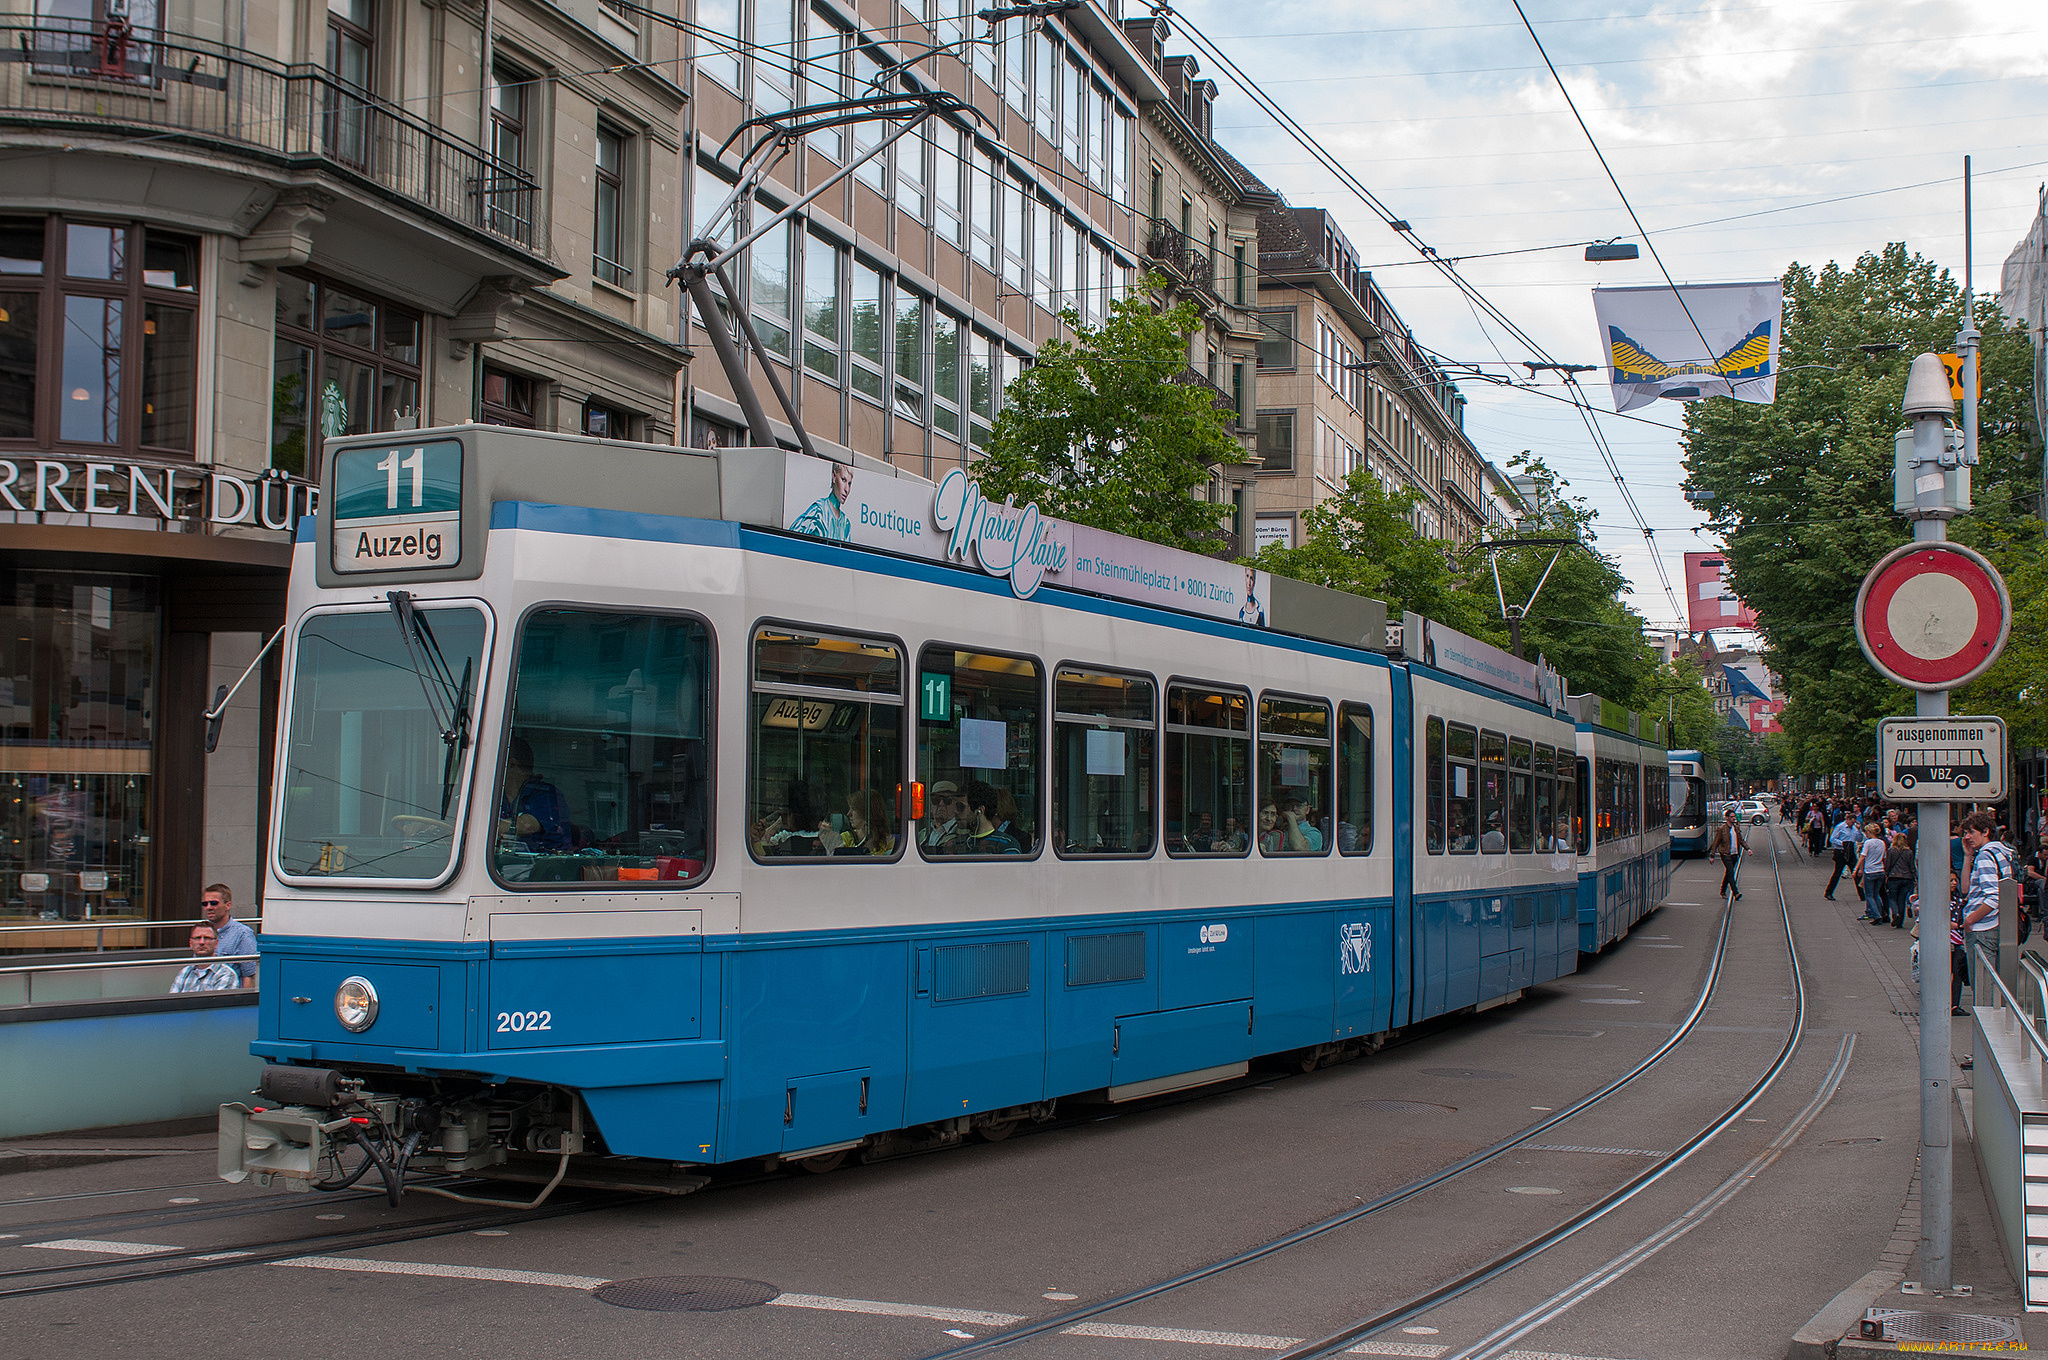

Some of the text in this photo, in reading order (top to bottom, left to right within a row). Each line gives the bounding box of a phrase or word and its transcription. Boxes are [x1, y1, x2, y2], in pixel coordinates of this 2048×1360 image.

[377, 447, 424, 509] 11
[355, 528, 442, 560] Auzelg
[860, 470, 1234, 604] Boutique Marie Claire am Steinmühleplatz 1 8001 Zürich
[925, 679, 945, 715] 11
[773, 700, 853, 727] Auzelg 11
[1896, 728, 1984, 743] ausgenommen
[1930, 767, 1952, 780] VBZ
[496, 1010, 552, 1033] 2022
